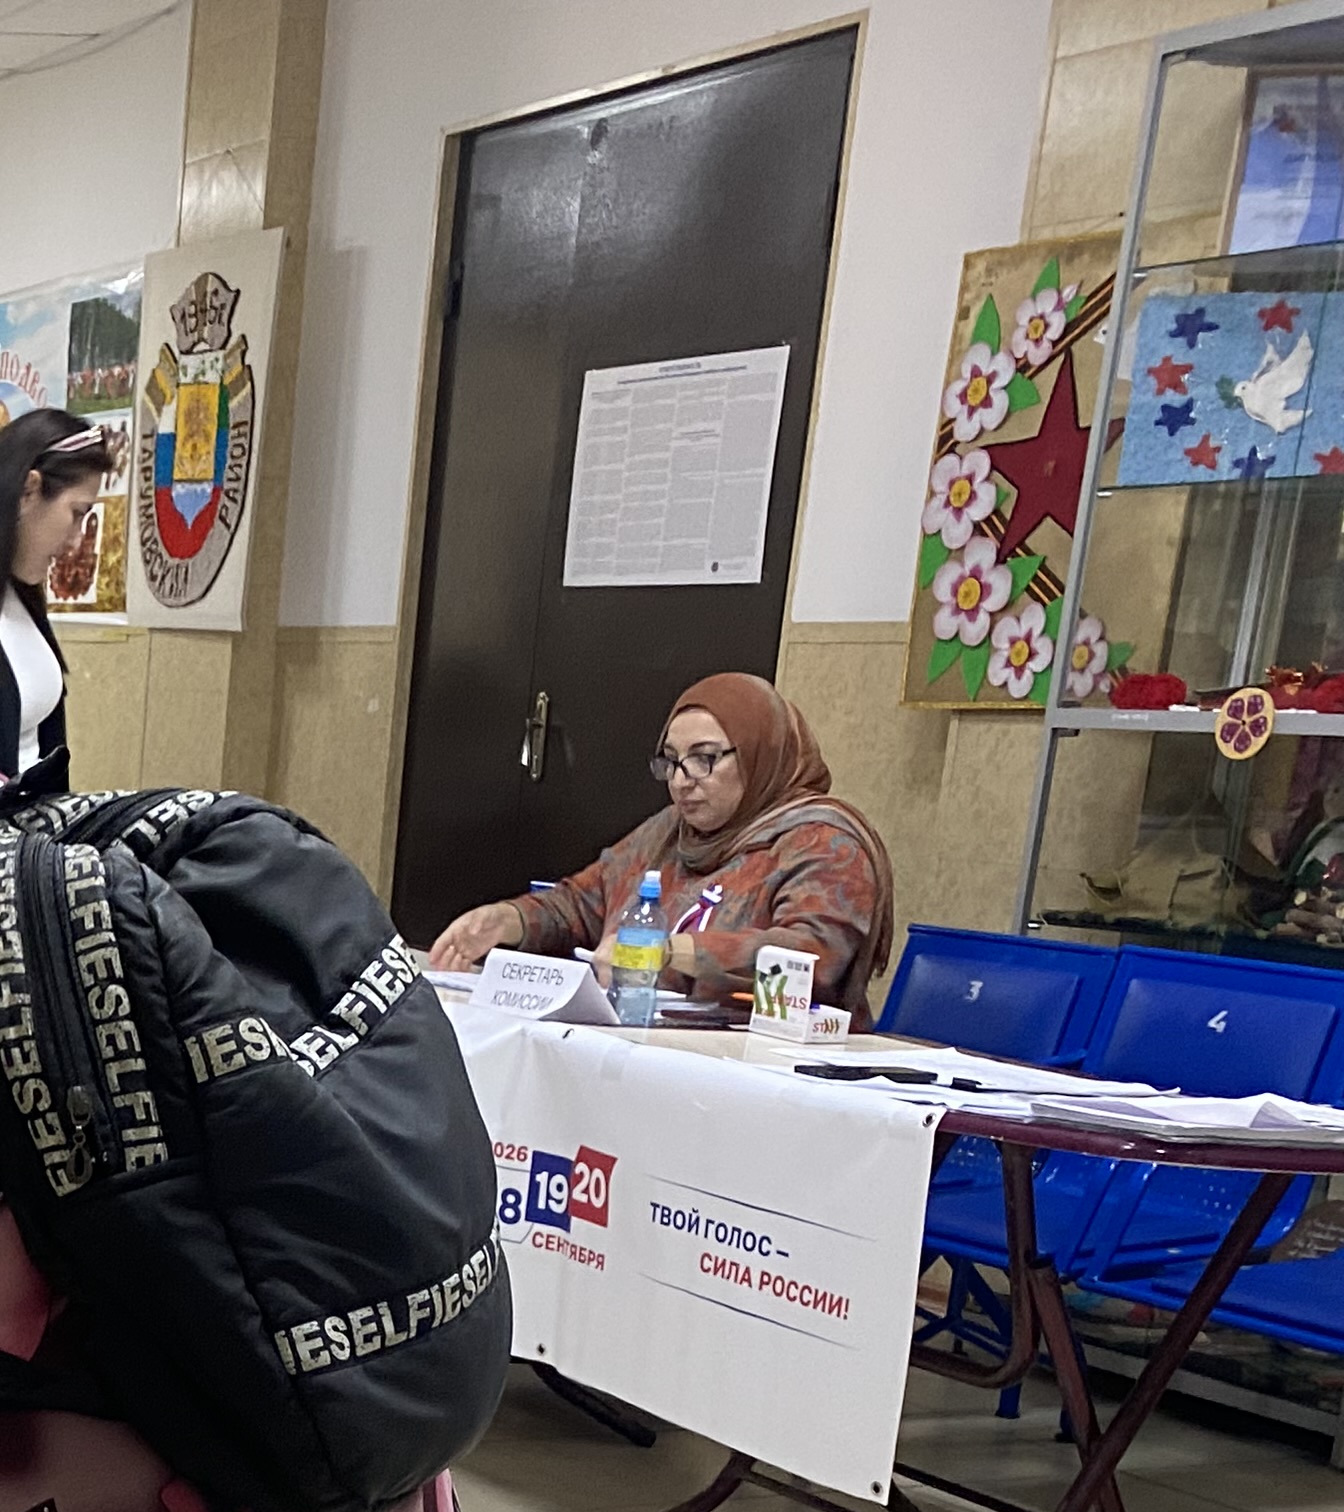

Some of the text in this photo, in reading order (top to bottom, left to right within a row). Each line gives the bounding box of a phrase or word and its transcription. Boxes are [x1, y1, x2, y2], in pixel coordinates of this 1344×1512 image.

[502, 962, 564, 986] СЕКРЕТАРЬ
[965, 980, 983, 1001] 3
[1207, 1010, 1228, 1033] 4
[493, 1142, 529, 1162] 026
[499, 1161, 607, 1225] 8 19 20
[649, 1201, 700, 1236] ТВОЙ
[704, 1219, 772, 1258] ГОЛОС
[532, 1231, 606, 1272] СЕНТЯБРЯ
[699, 1251, 850, 1320] СИЛА РОССИИ!
